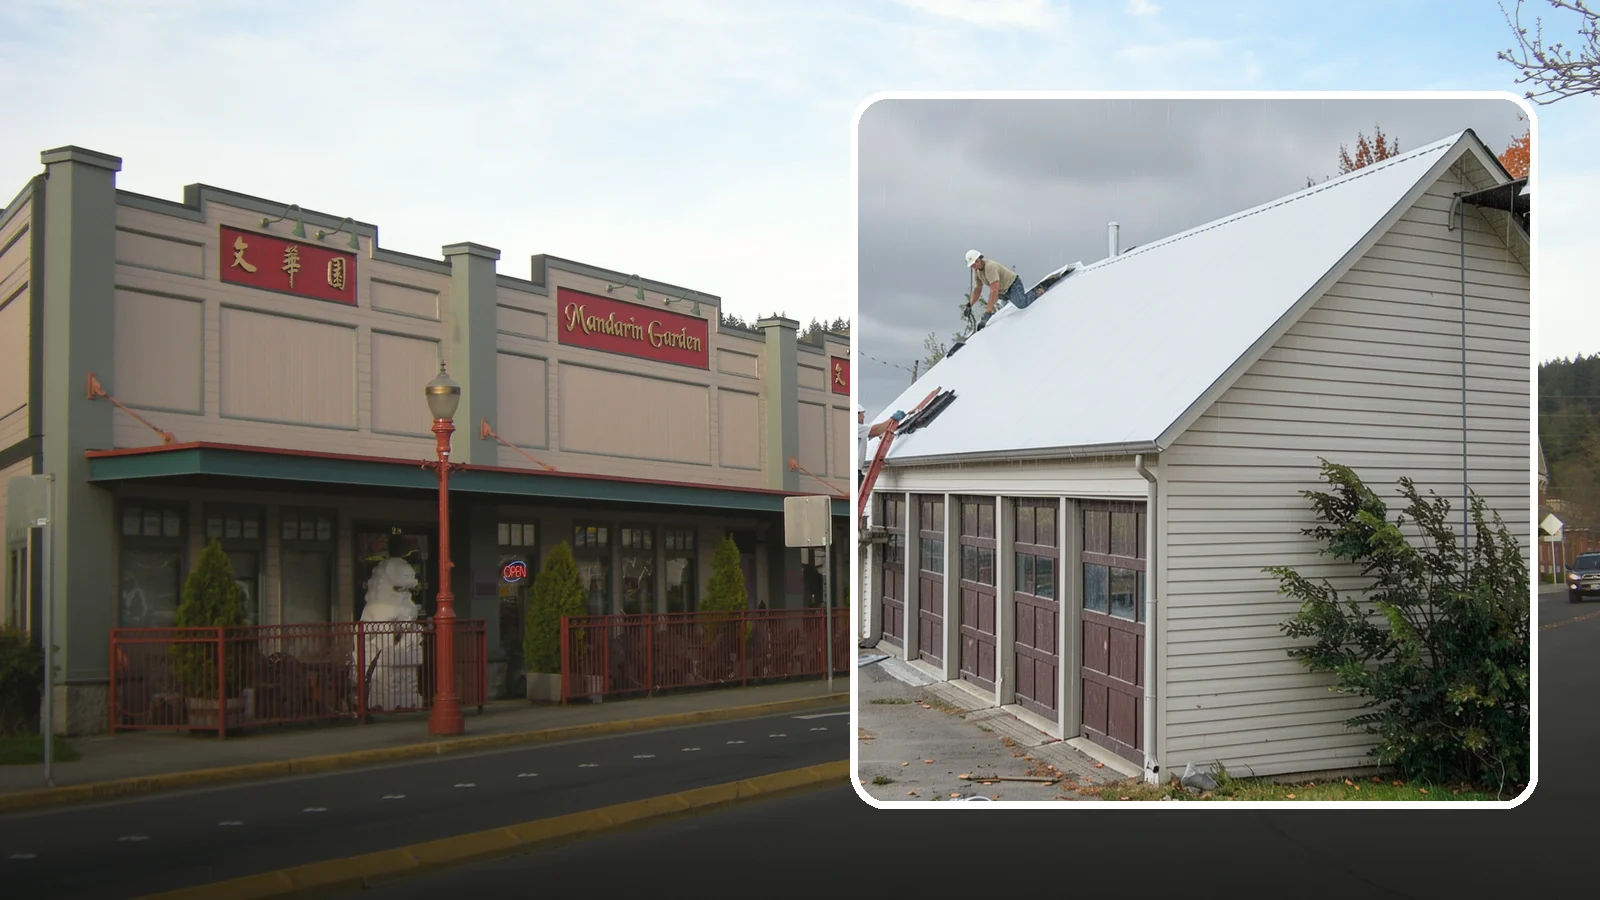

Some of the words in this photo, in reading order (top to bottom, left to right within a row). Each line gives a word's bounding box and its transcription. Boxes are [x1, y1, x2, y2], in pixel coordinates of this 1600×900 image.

[231, 235, 346, 291] 文華園
[564, 302, 644, 341] Mandarin
[647, 319, 702, 352] Garden
[503, 565, 527, 578] OPEN
